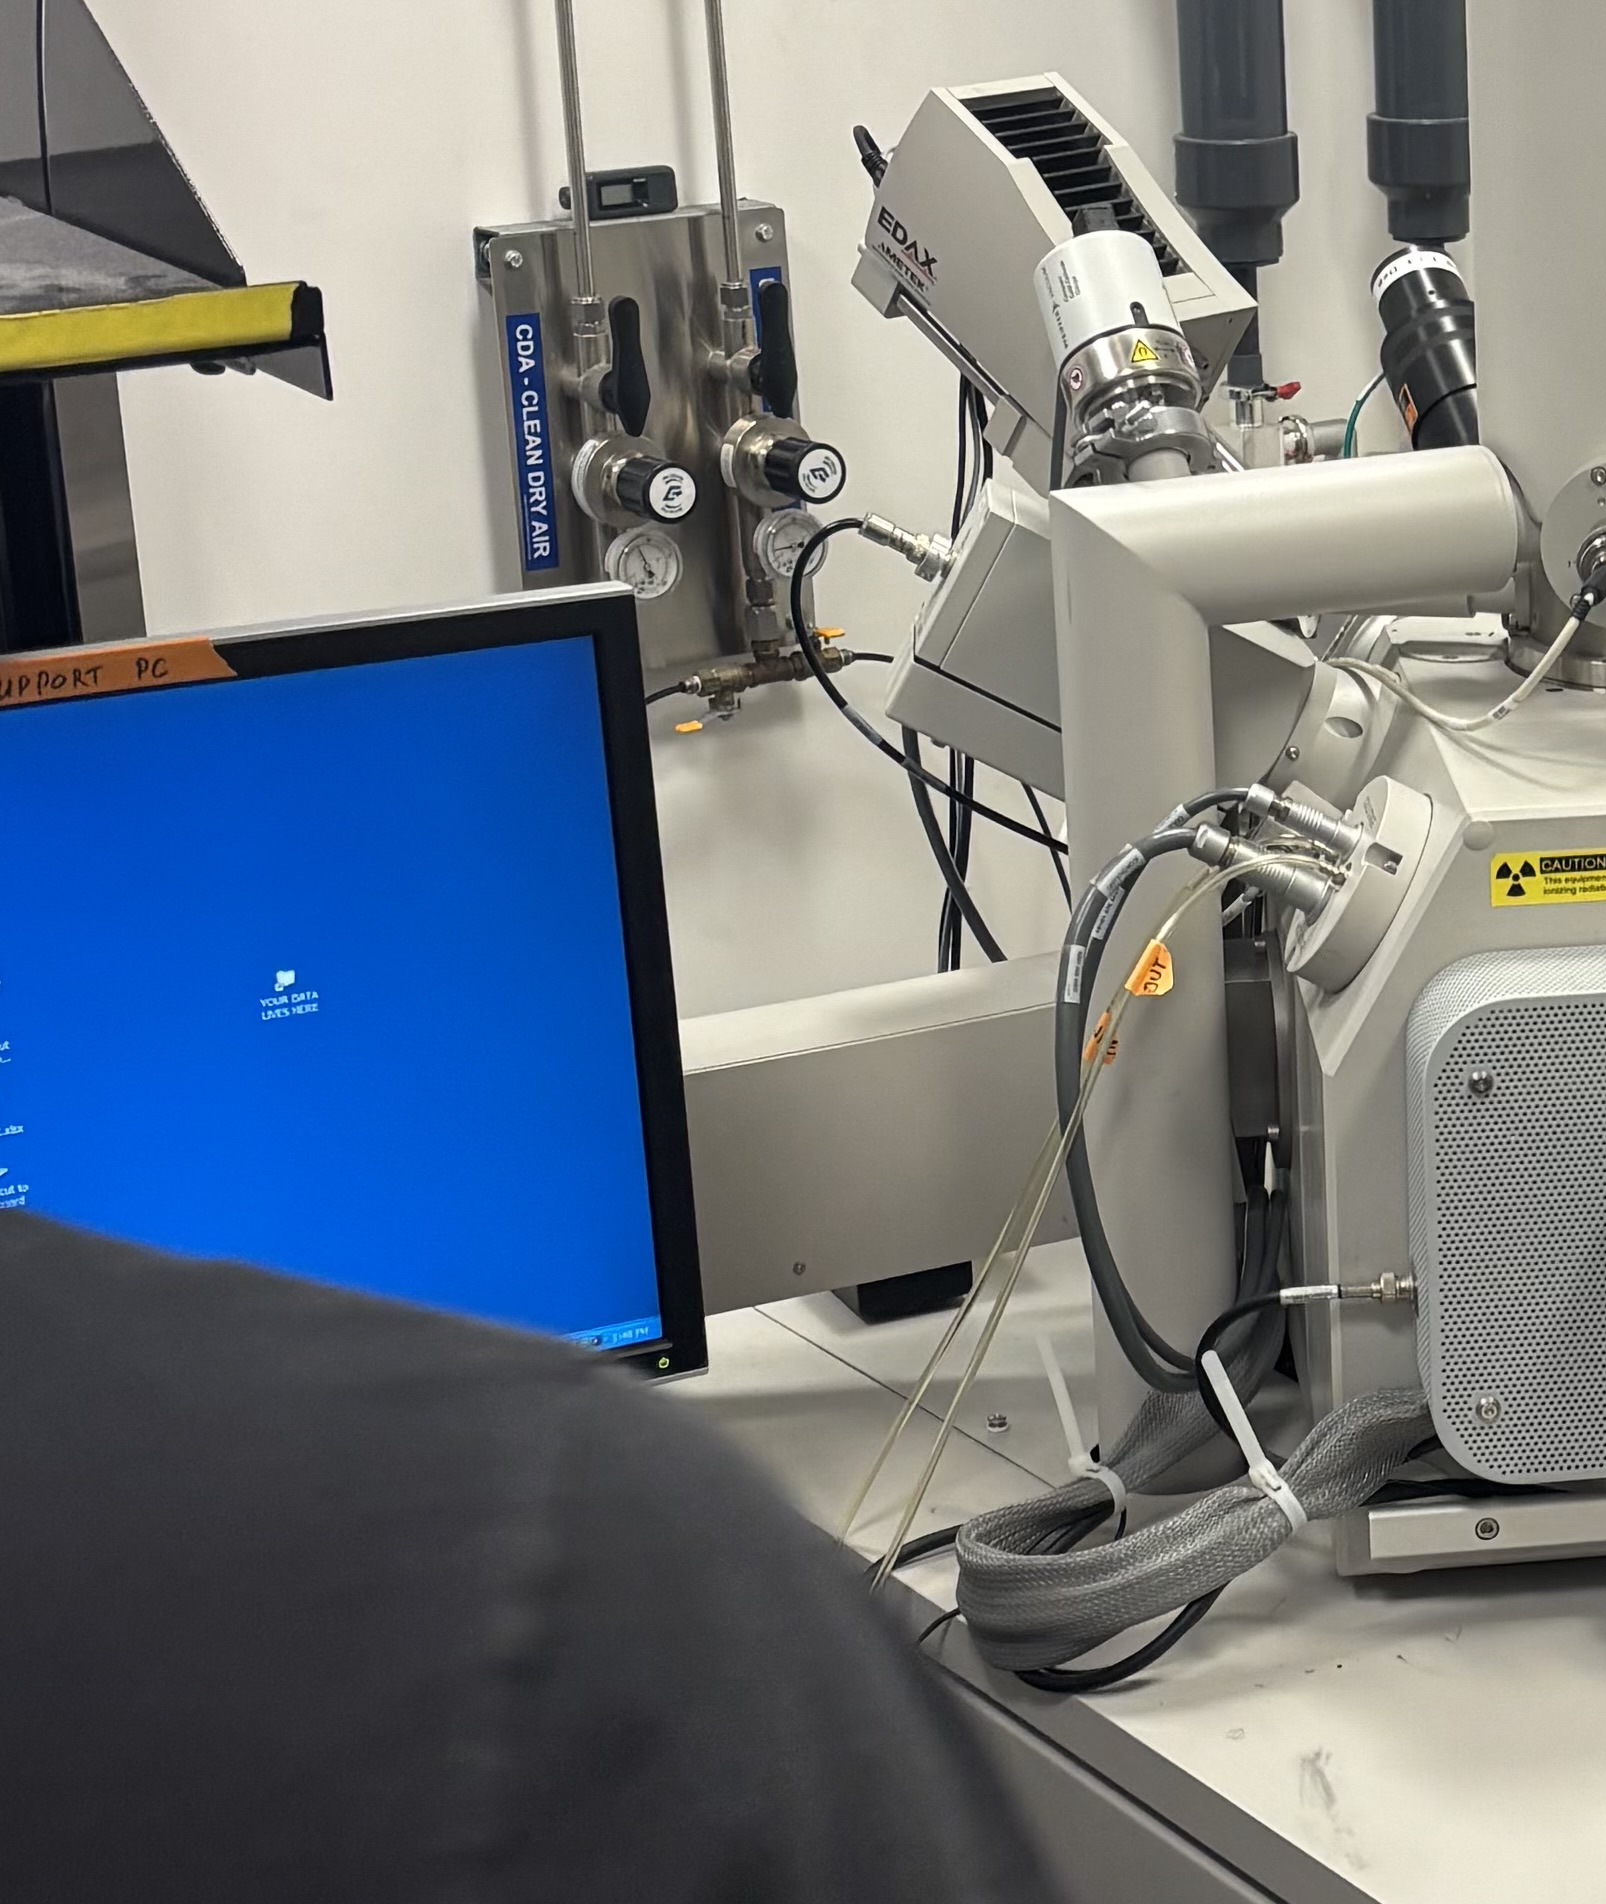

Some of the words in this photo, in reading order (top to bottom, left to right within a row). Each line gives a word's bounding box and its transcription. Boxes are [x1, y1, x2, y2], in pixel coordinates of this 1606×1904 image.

[877, 205, 938, 277] EDAX
[877, 241, 926, 293] AMETEK
[515, 323, 536, 373] CDA
[521, 390, 543, 466] CLEAN
[527, 471, 548, 516] DRY
[531, 520, 550, 559] AIR
[0, 665, 103, 700] UPPORT
[136, 656, 168, 681] PC
[1543, 875, 1563, 885] This
[1543, 885, 1577, 896] ionizing
[1144, 957, 1166, 993] OUT
[260, 995, 289, 1007] YOUR
[291, 991, 319, 1003] DATA
